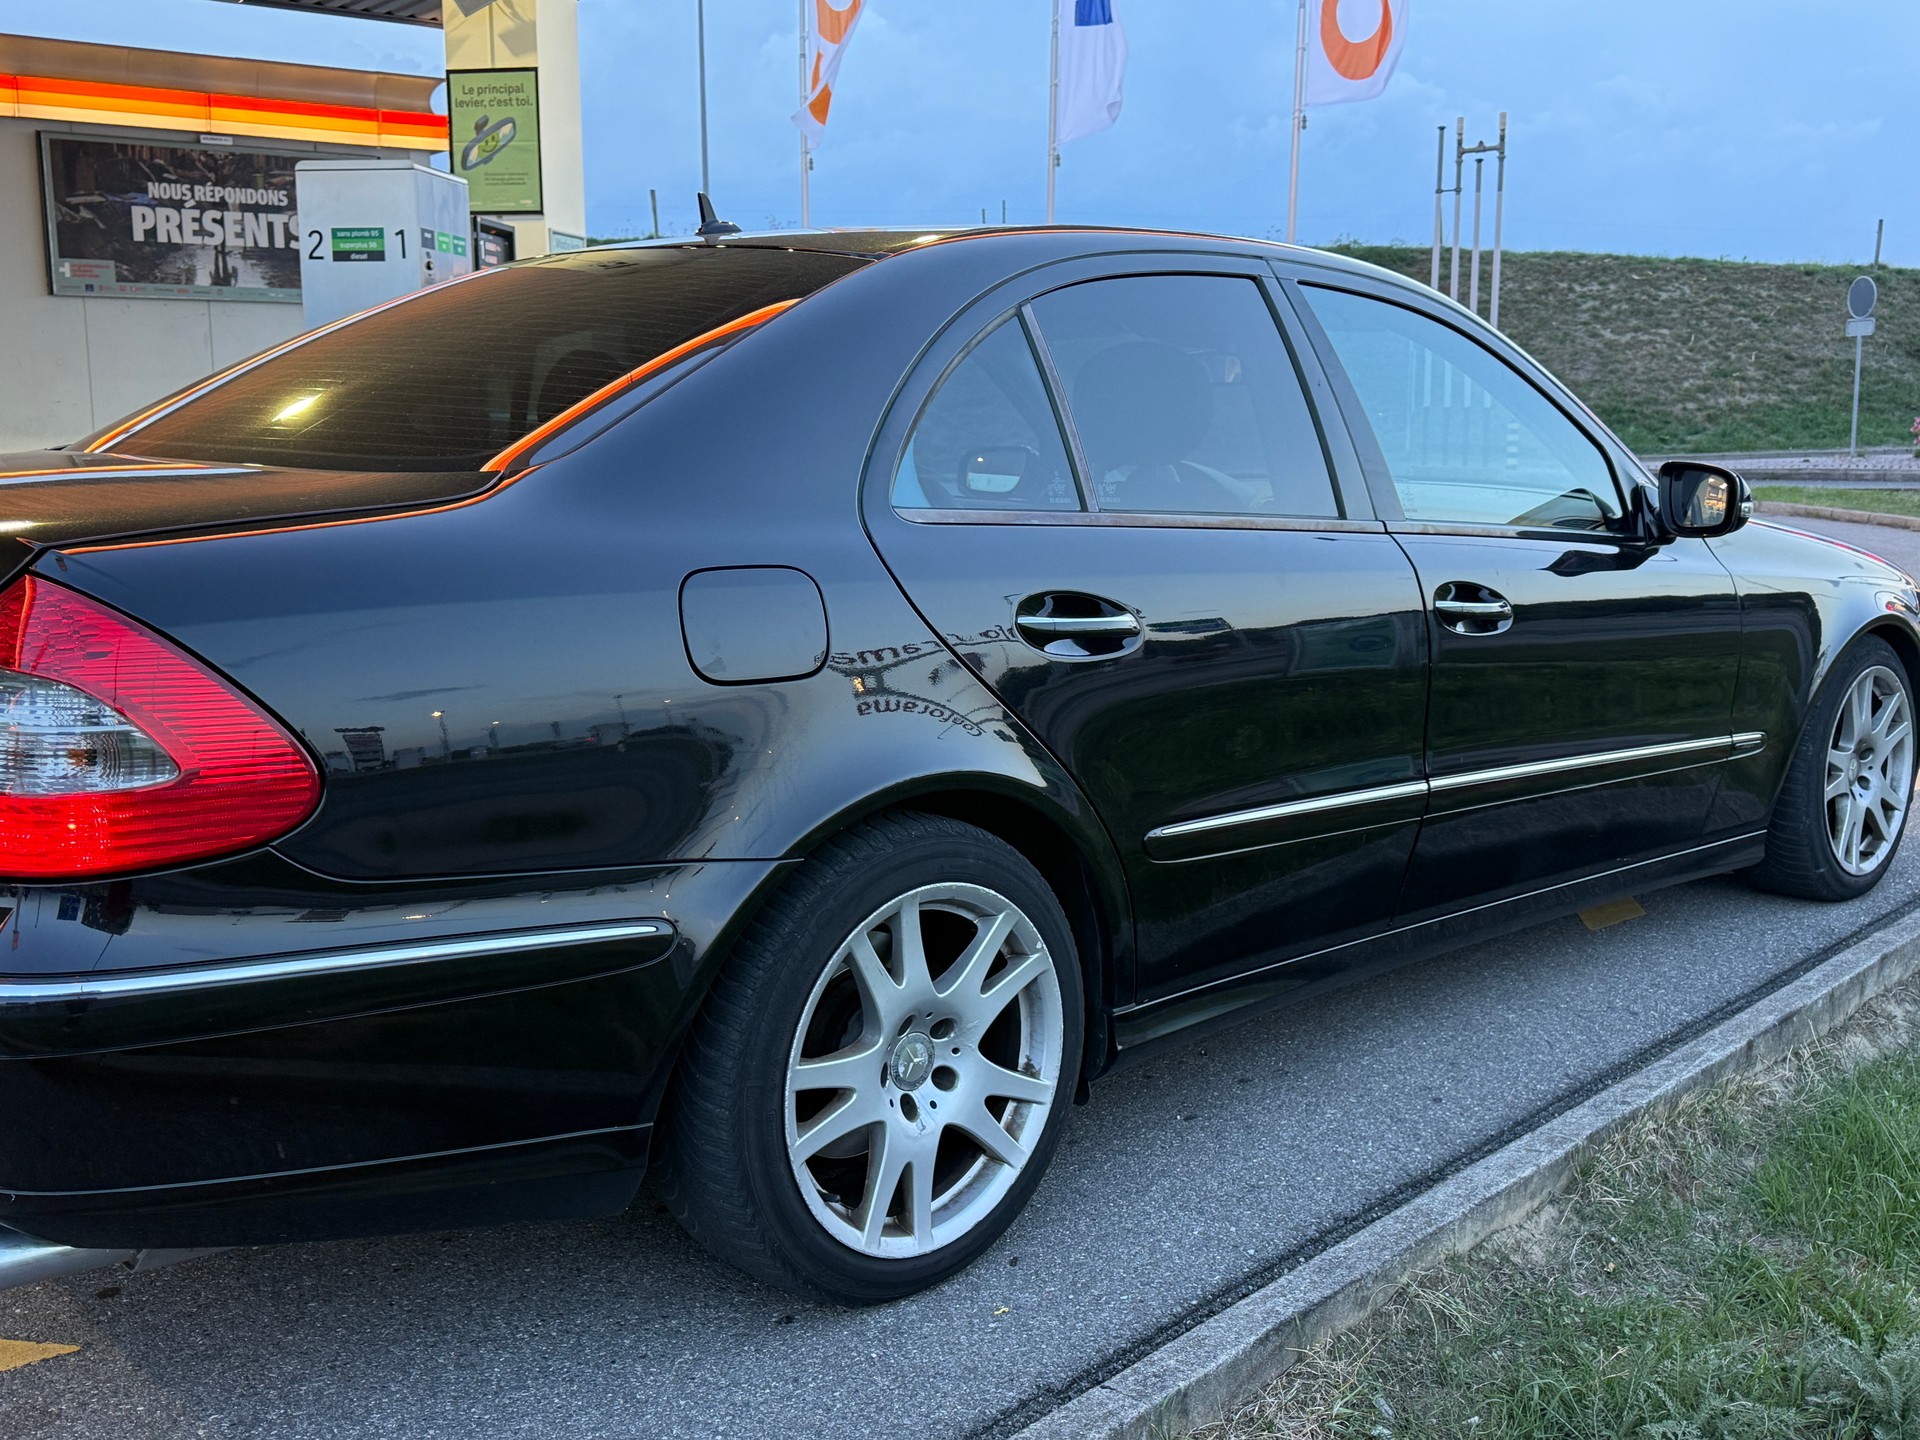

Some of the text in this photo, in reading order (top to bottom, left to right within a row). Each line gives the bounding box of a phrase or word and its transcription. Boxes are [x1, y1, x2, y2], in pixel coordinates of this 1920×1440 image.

[462, 83, 524, 97] Le principal
[455, 97, 487, 109] levier,
[516, 96, 534, 107] toi.
[147, 181, 288, 207] NOUS RÉPONDONS
[351, 230, 370, 238] plomb
[395, 228, 406, 259] 1
[308, 229, 324, 260] 2
